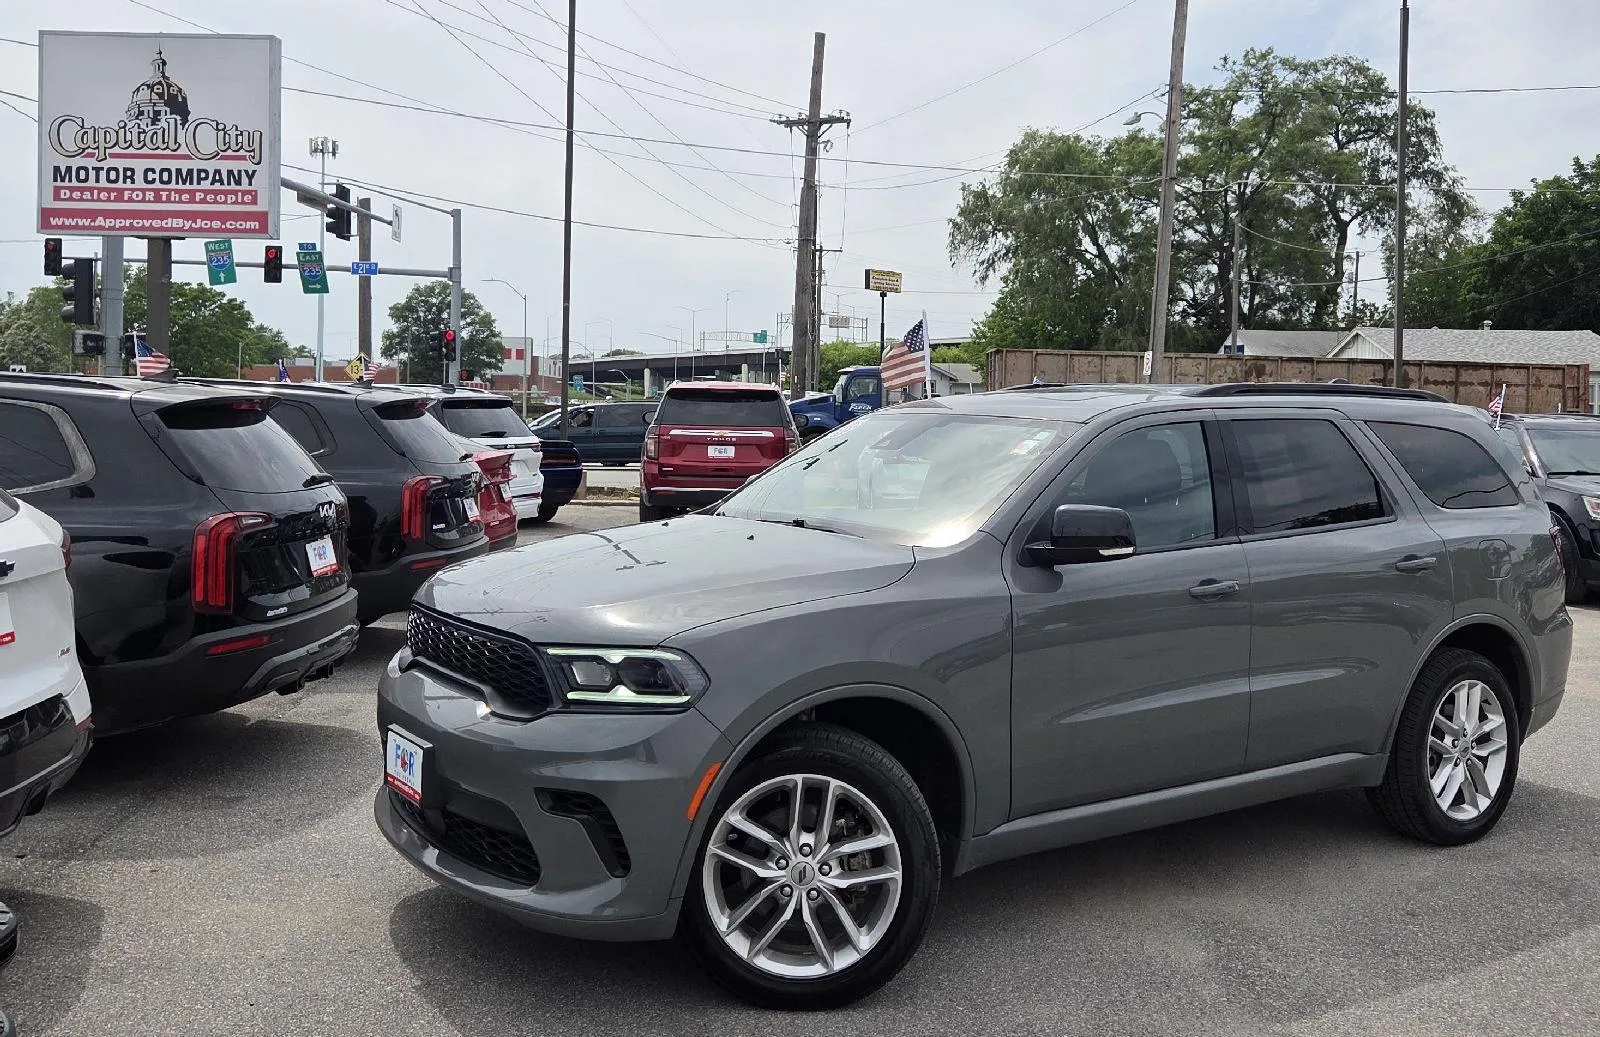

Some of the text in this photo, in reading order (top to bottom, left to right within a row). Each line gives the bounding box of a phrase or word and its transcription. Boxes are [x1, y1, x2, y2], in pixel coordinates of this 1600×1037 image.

[48, 114, 263, 165] Capital City
[53, 165, 258, 187] MOTOR COMPANY
[60, 189, 253, 205] Dealer FOR The People
[49, 216, 260, 231] www.ApprovedByJoe.com
[207, 242, 229, 251] WEST
[210, 255, 230, 266] 235
[299, 253, 320, 261] EAST
[303, 266, 322, 276] 235
[395, 743, 415, 778] FOR
